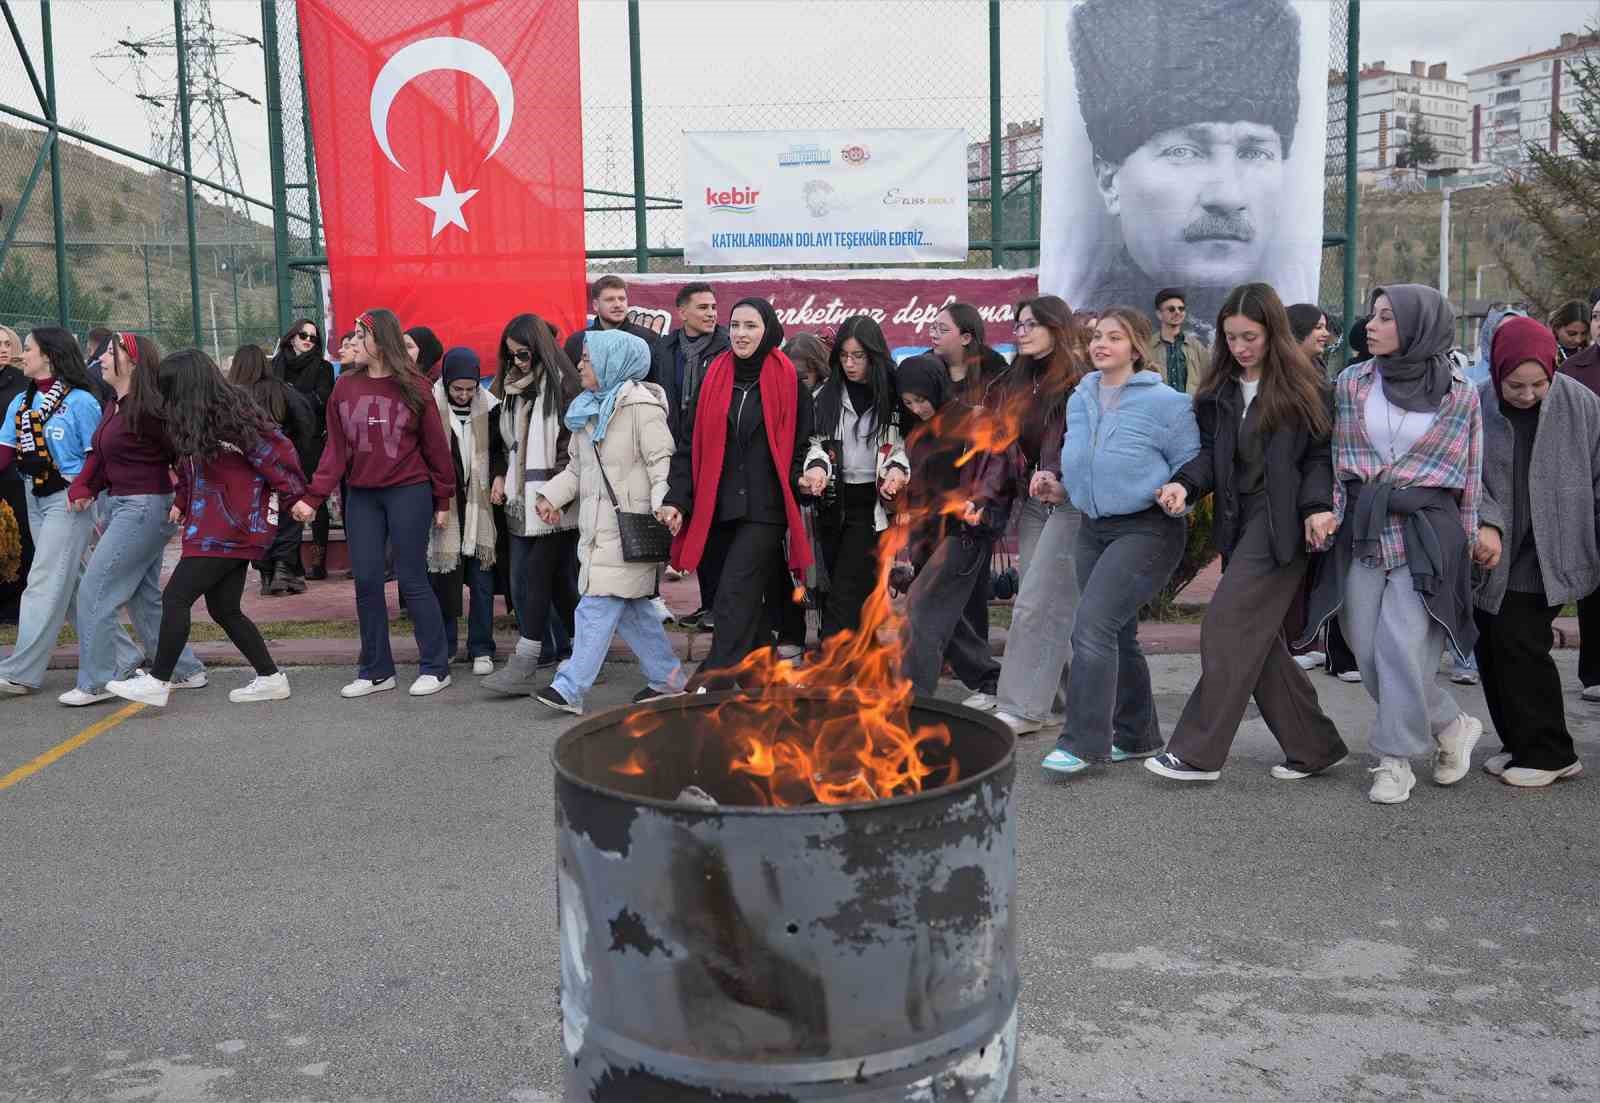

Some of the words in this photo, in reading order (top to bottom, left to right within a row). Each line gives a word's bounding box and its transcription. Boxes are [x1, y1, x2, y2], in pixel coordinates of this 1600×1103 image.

[706, 186, 760, 205] kebir
[712, 232, 793, 248] KATKILARINDAN
[796, 232, 832, 247] DOLAYI
[834, 229, 887, 249] TEŞEKKÜR
